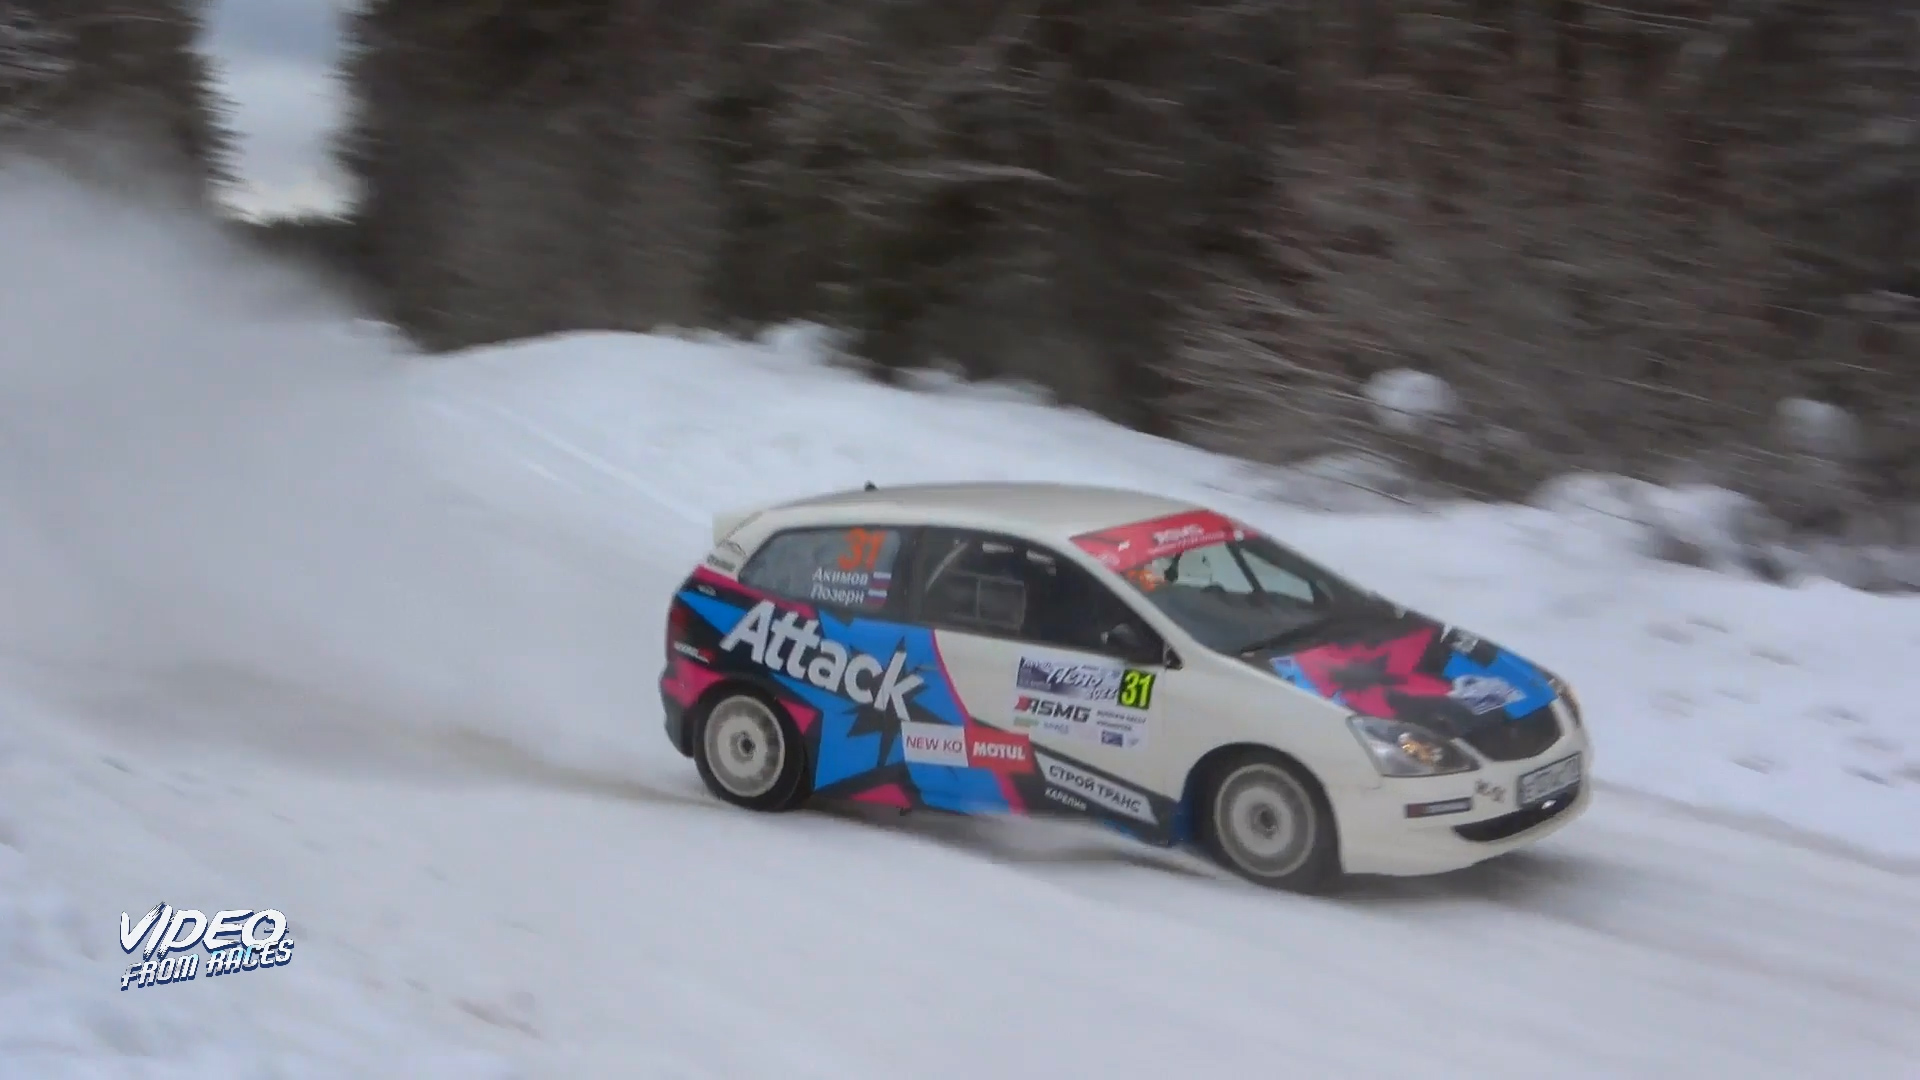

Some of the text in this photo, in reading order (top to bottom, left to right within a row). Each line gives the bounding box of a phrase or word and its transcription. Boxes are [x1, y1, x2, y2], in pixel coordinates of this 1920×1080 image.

[837, 526, 888, 572] 31
[811, 567, 868, 586] Акимов
[719, 599, 923, 722] Attack
[1121, 669, 1151, 707] 31
[906, 734, 939, 752] NEW
[972, 741, 1026, 761] MOTUL
[1049, 764, 1141, 813] СТРОЙ ТРАНС
